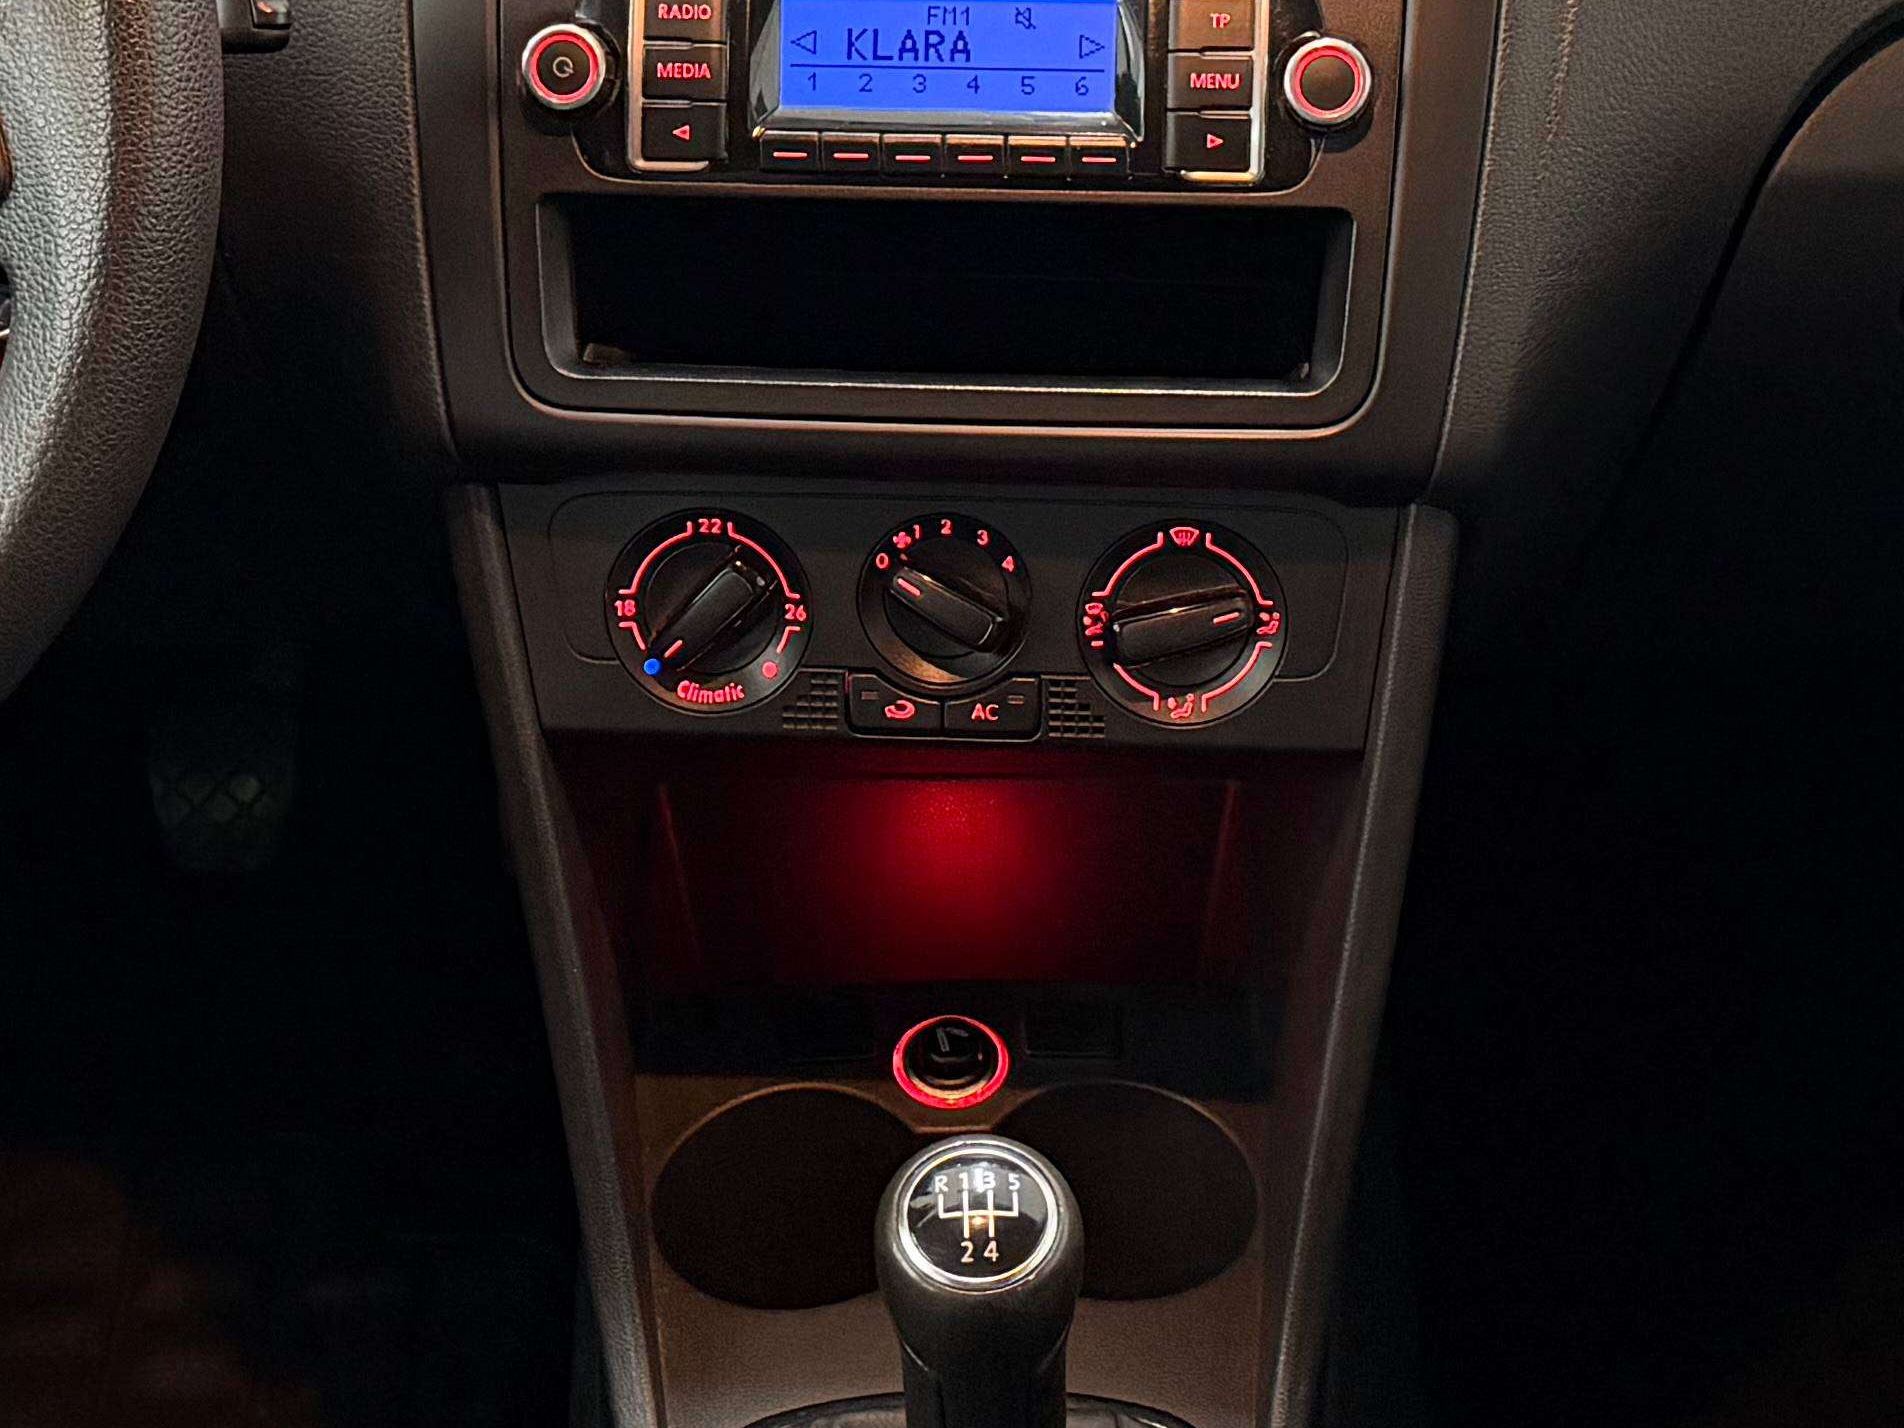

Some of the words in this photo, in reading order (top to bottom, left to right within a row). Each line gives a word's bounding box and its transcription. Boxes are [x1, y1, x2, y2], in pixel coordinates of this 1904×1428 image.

[658, 3, 712, 20] RADIO
[927, 5, 971, 26] FM1
[1209, 12, 1231, 29] TP
[847, 28, 971, 63] KLARA
[656, 62, 712, 80] MEDIA
[807, 72, 817, 91] 1
[858, 74, 873, 93] 2
[912, 74, 927, 94] 3
[966, 75, 980, 94] 4
[1021, 76, 1035, 96] 5
[1075, 76, 1090, 96] 6
[1189, 72, 1241, 90] MENU
[698, 518, 722, 534] 22
[875, 552, 890, 570] 0
[912, 524, 921, 540] 1
[940, 518, 953, 536] 2
[976, 529, 990, 546] 3
[1001, 555, 1016, 573] 4
[614, 599, 637, 617] 18
[784, 603, 807, 622] 26
[677, 679, 746, 704] Climatic
[970, 703, 999, 721] AC
[935, 1175, 949, 1193] R
[958, 1172, 969, 1189] 1
[1008, 1173, 1021, 1191] 5
[960, 1241, 974, 1263] 2
[983, 1240, 1000, 1262] 4
